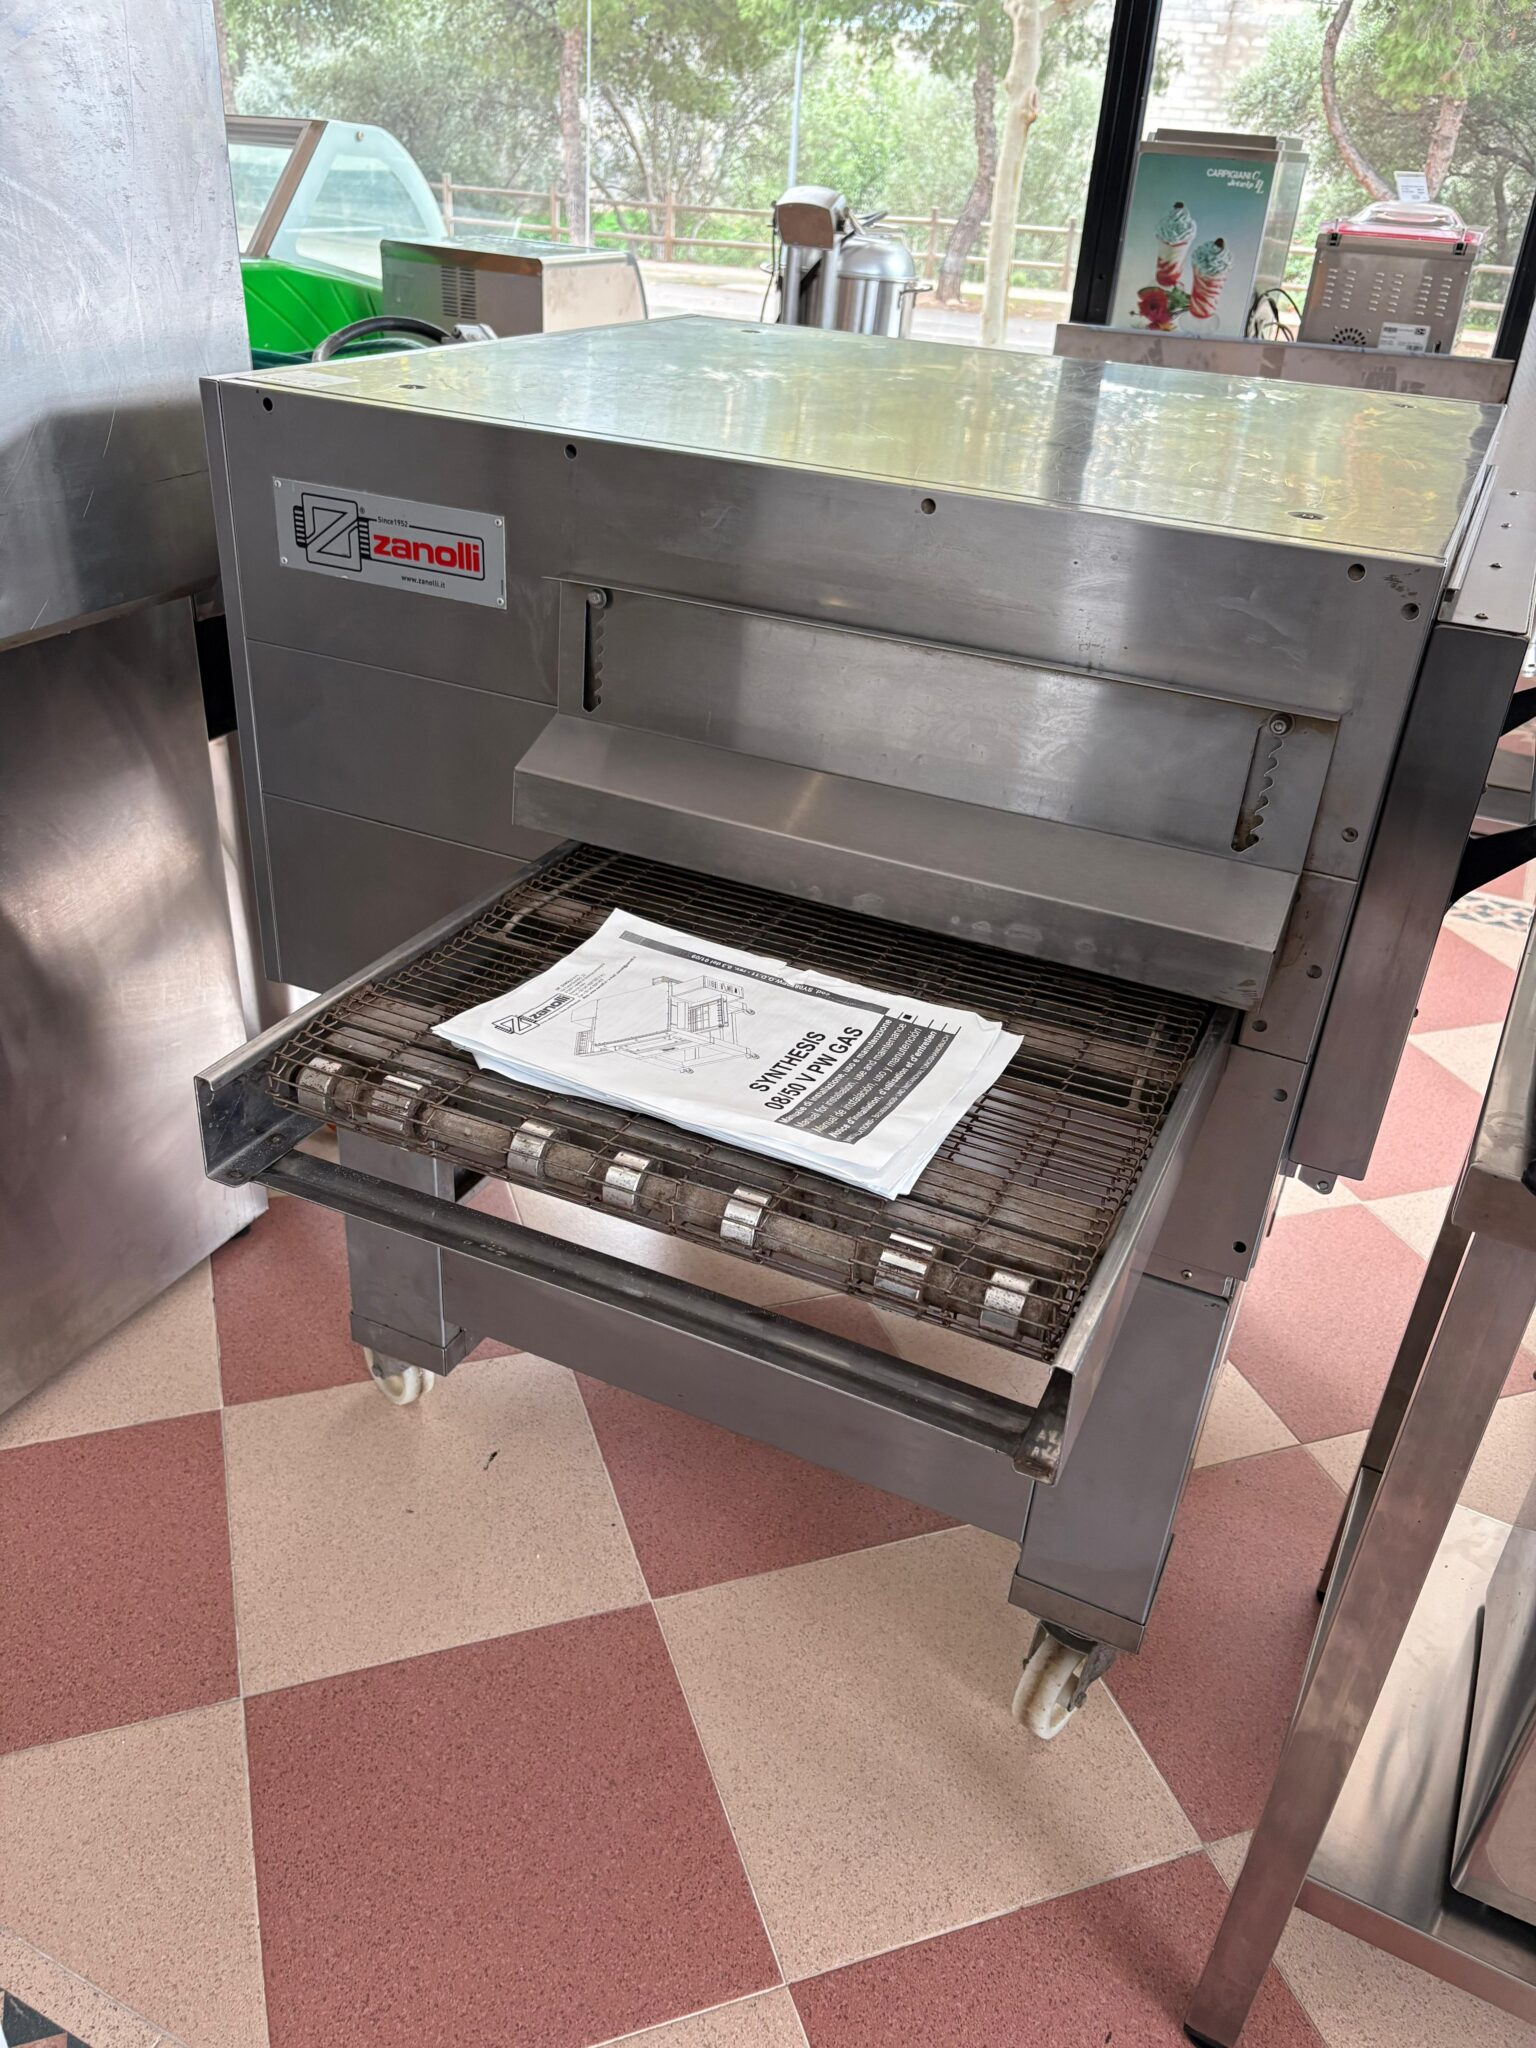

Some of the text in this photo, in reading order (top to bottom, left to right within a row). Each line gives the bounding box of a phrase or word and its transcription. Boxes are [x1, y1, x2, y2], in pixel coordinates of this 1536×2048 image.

[1206, 168, 1251, 179] CARPIGIANI
[378, 516, 408, 528] Since1952
[373, 534, 480, 572] zanolli
[401, 574, 446, 589] www.zanolli.it
[529, 994, 571, 1020] zanolli
[749, 1031, 826, 1092] SYNTHESIS
[764, 1027, 863, 1110] 08/50 V PW GAS
[778, 1106, 807, 1124] Manuale
[843, 1062, 856, 1073] uso
[857, 1019, 892, 1059] manutenzione
[793, 1112, 820, 1128] Manual
[854, 1070, 867, 1080] use
[864, 1060, 877, 1071] and
[873, 1023, 907, 1061] maintenance
[811, 1115, 839, 1133] Manual
[834, 1109, 847, 1117] de
[873, 1071, 887, 1082] uso
[887, 1027, 922, 1068] manutención
